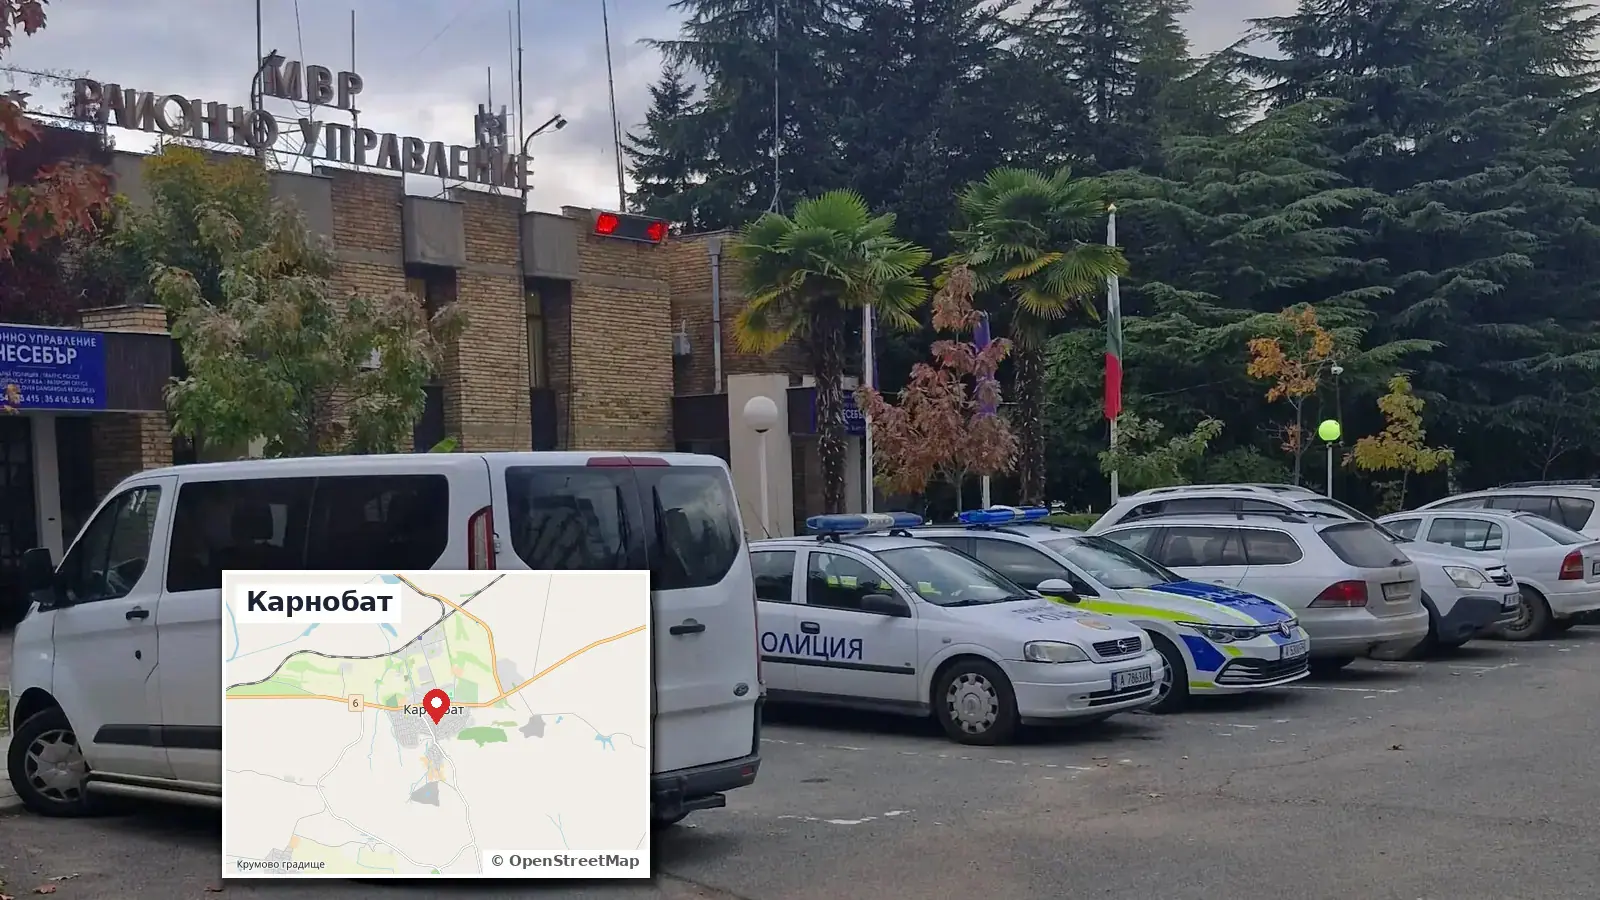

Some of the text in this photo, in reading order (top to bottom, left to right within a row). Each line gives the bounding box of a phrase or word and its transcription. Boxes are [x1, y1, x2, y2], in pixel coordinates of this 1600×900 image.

[263, 55, 363, 110] МВР
[298, 118, 534, 191] УПРАВЛЕНИЕ
[0, 332, 97, 347] ННО УПРАВЛЕНИЕ
